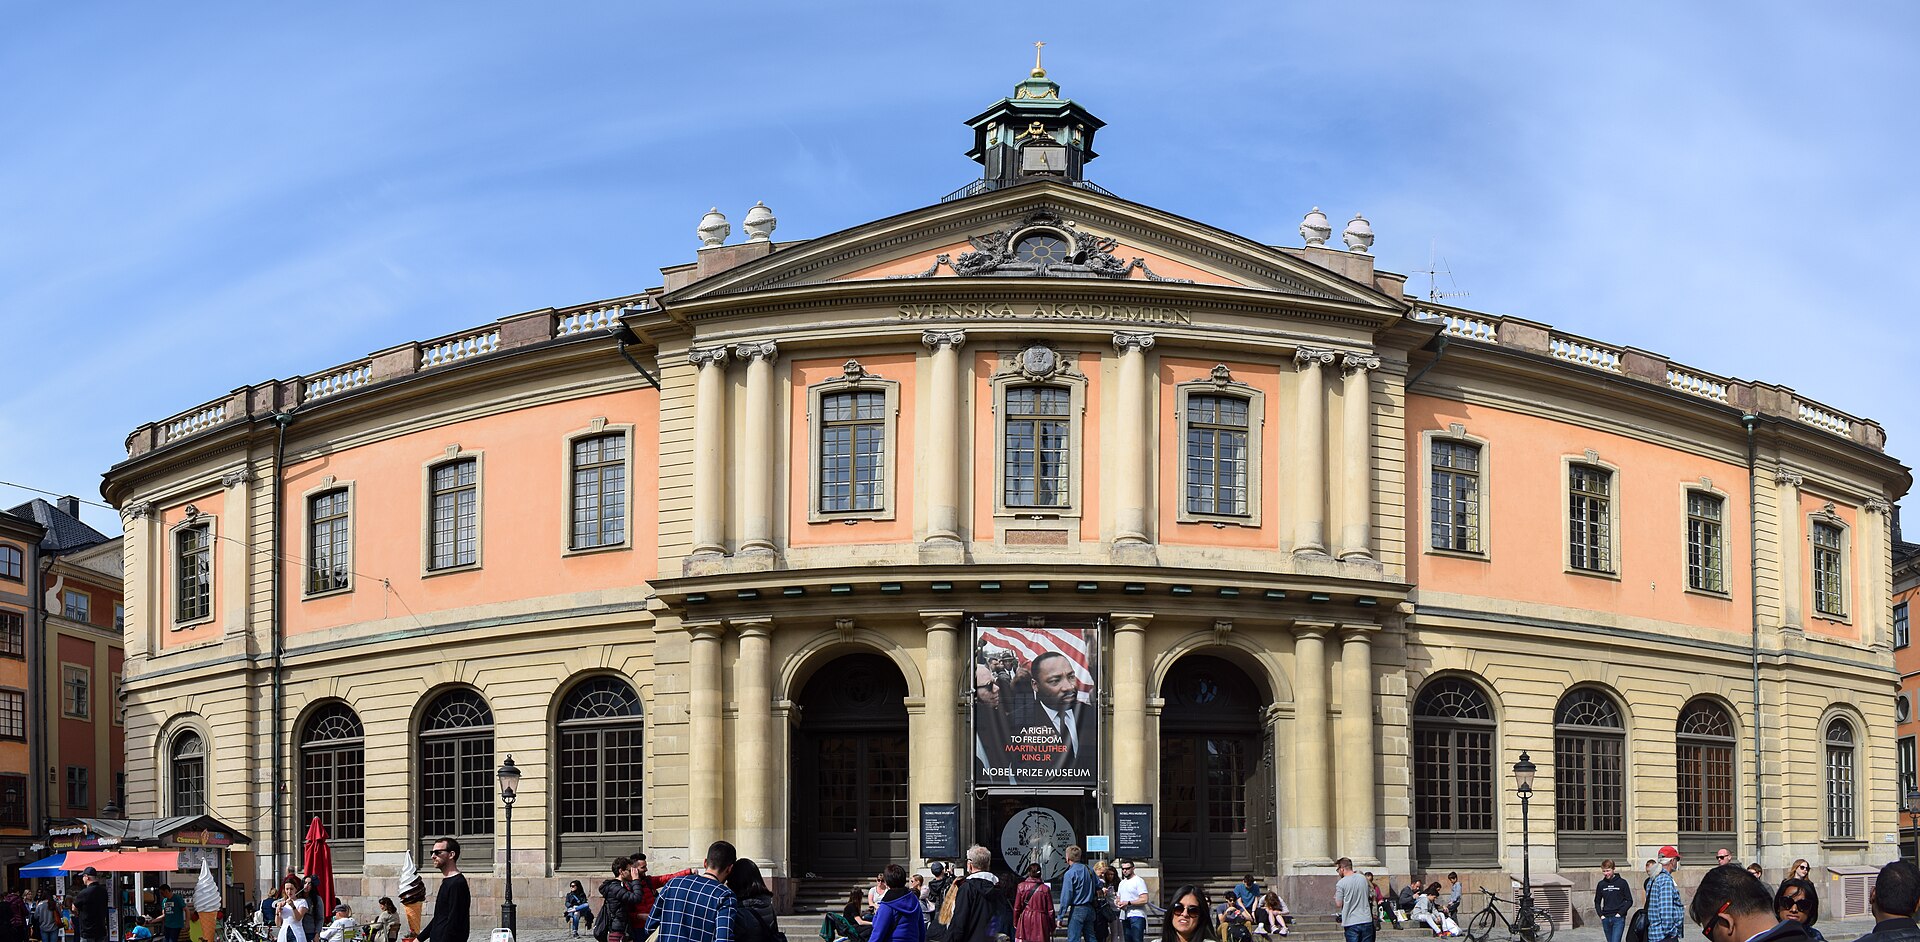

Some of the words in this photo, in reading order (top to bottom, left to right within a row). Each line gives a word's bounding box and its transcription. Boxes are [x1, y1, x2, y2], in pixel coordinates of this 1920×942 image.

[898, 302, 1016, 319] SVENSKA
[1030, 302, 1192, 325] AKADEMIEN
[1020, 727, 1028, 735] A
[1029, 727, 1053, 735] RIGHT
[1023, 736, 1063, 744] FREEDOM
[982, 768, 1015, 776] NOBEL
[1016, 768, 1043, 777] PRIZE
[1044, 768, 1091, 777] MUSEUM
